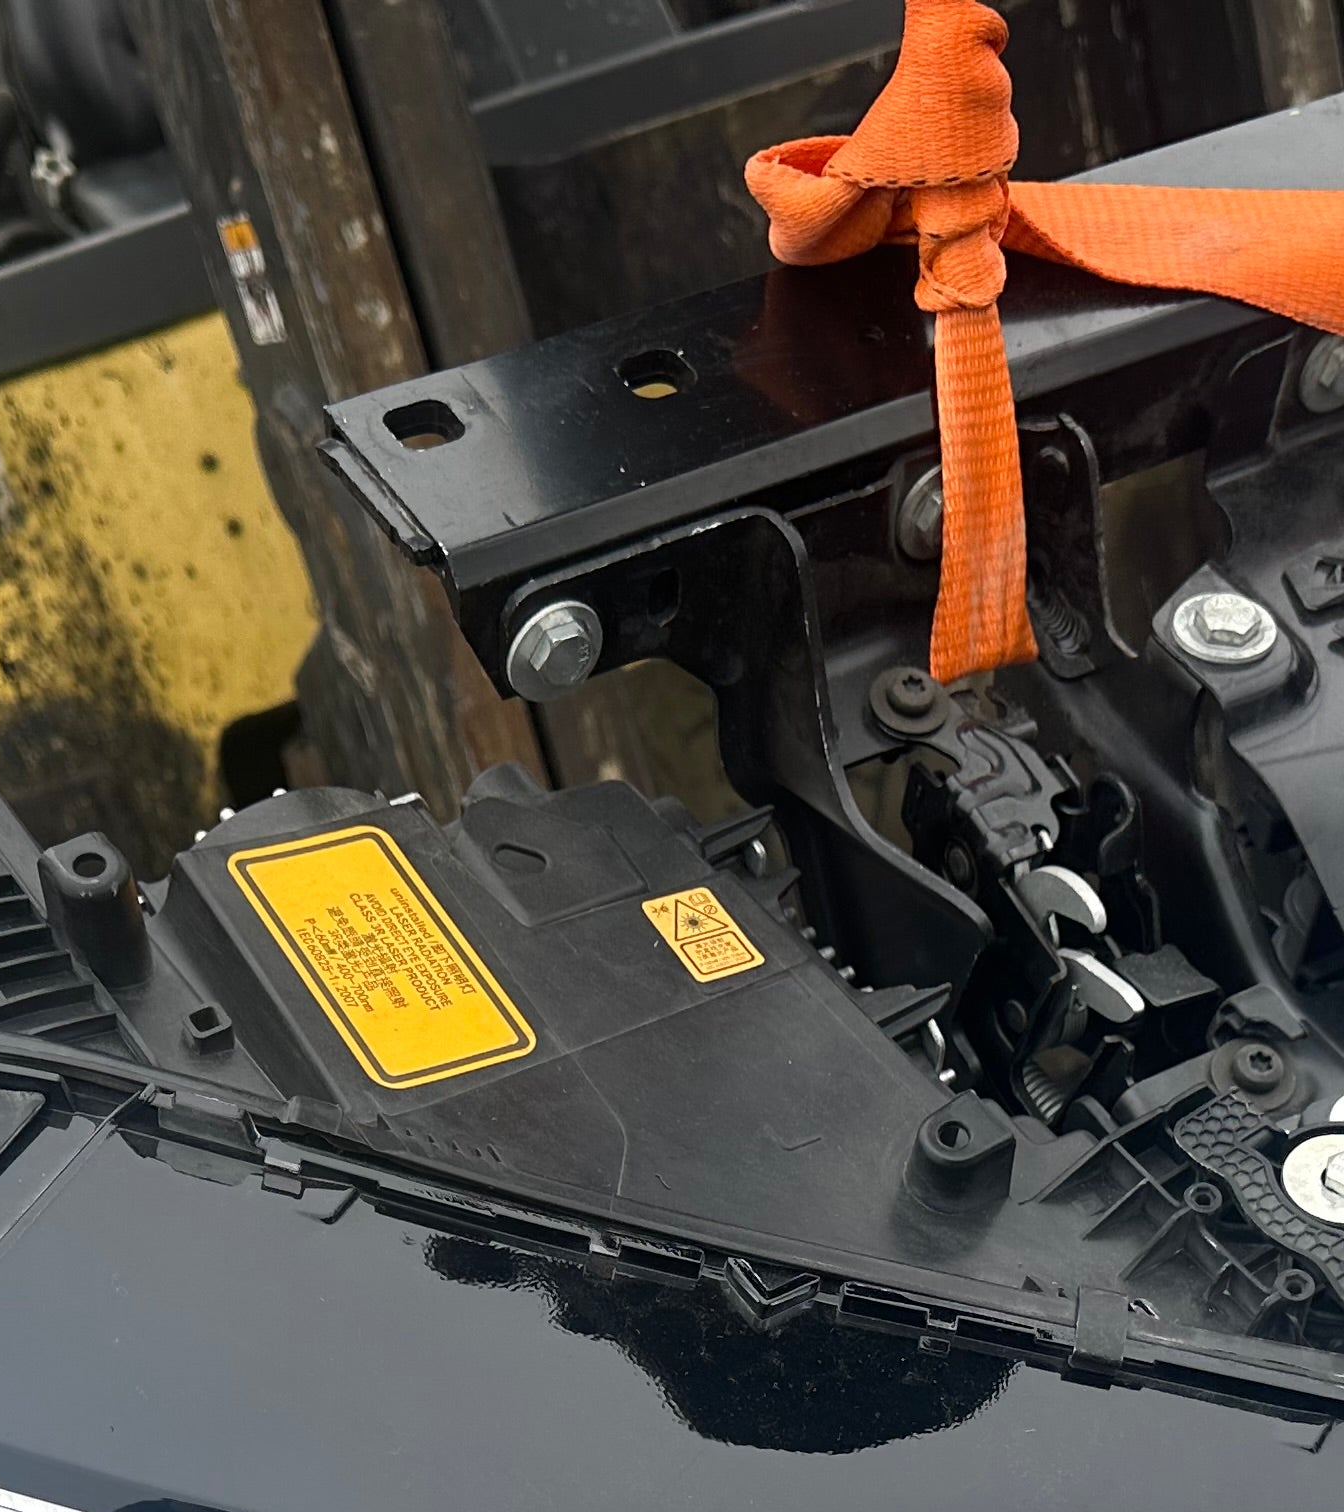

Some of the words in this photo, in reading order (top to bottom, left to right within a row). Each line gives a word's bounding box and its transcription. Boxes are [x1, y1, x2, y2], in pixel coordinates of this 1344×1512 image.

[350, 894, 376, 922] CLASS
[371, 924, 385, 935] 3R
[380, 937, 408, 966] LASER
[403, 967, 440, 1010] PRODUCT
[364, 894, 387, 916] AVOID
[382, 918, 409, 944] DIRECT
[403, 947, 420, 962] EYE
[415, 964, 452, 1006] EXPOSURE
[390, 907, 416, 936] LASER
[412, 937, 452, 985] RADIATION
